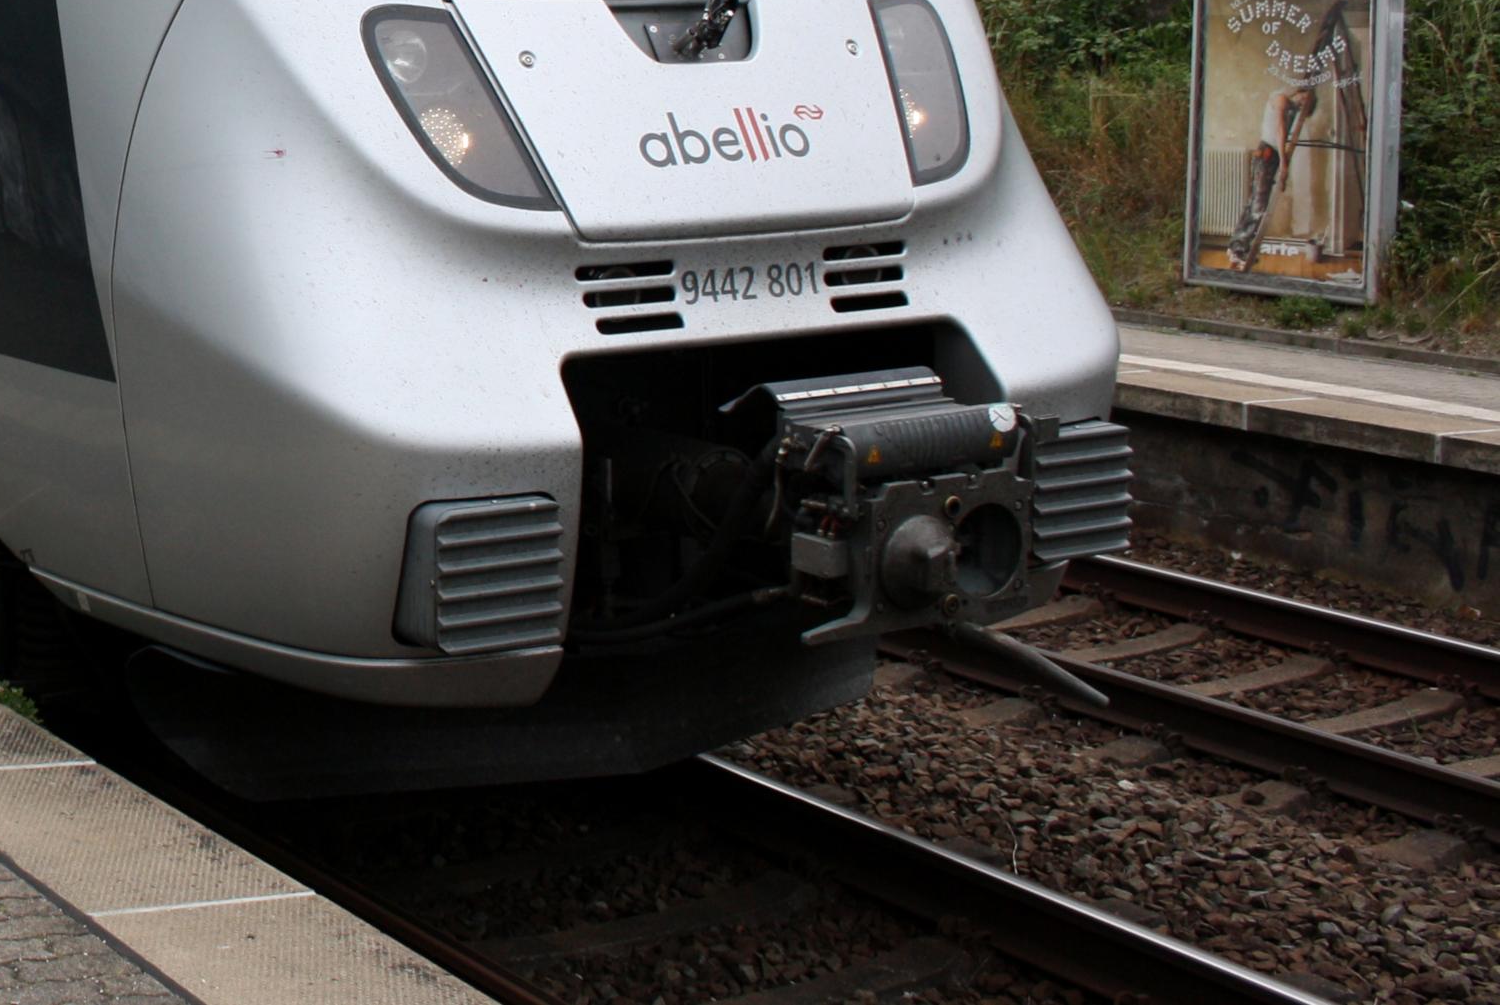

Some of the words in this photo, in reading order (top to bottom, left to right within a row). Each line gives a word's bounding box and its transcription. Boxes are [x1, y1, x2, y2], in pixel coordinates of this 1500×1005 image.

[1226, 0, 1312, 34] SUMMER
[1261, 21, 1282, 35] OF
[1265, 35, 1347, 73] DREAMS
[638, 107, 811, 168] abellio
[1259, 243, 1300, 256] arte
[680, 265, 758, 305] 9442
[767, 261, 821, 301] 801
